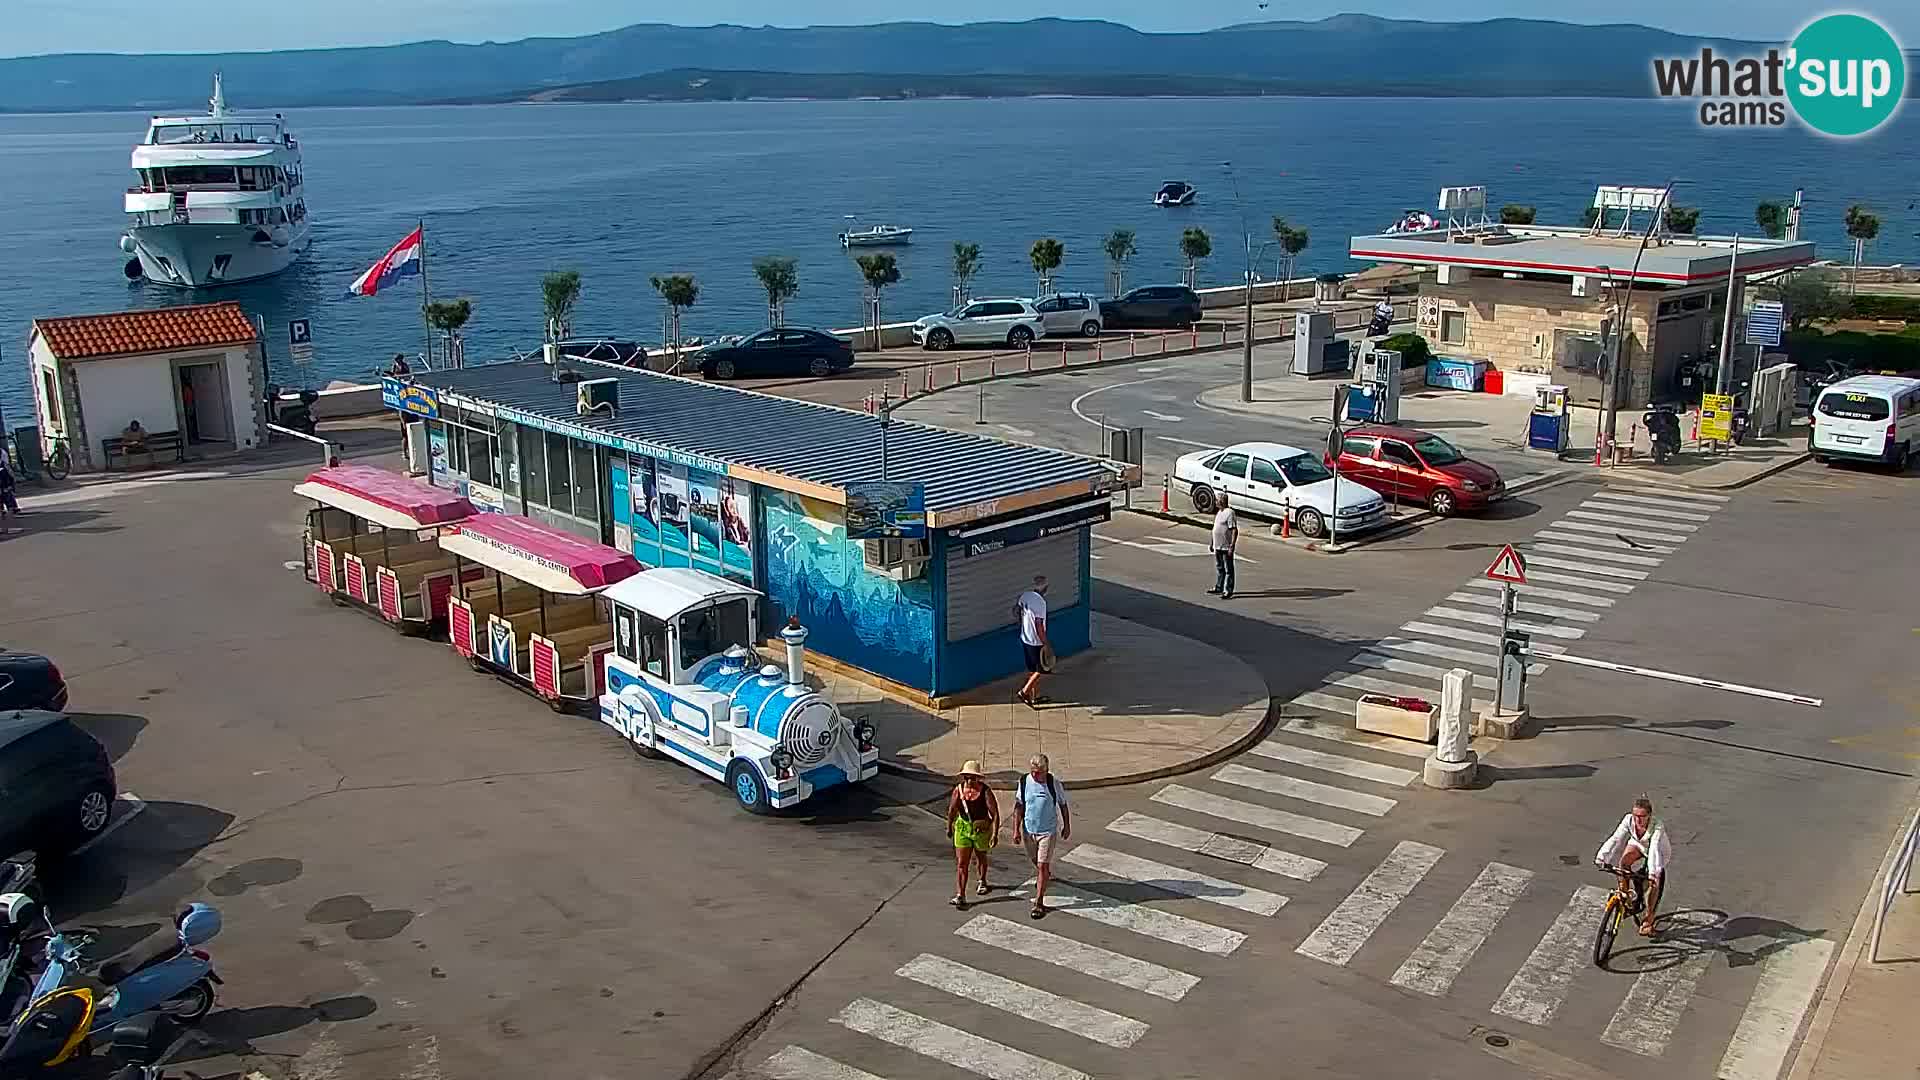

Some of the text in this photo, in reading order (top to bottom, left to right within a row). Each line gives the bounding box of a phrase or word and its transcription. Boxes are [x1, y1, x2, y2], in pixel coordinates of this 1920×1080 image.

[1846, 394, 1866, 403] TAXI
[543, 420, 584, 438] AUTOBUSNA
[583, 432, 613, 446] POSTAJA
[623, 440, 637, 452] BUS
[639, 444, 669, 460] STATION
[672, 451, 696, 466] TICKET
[698, 459, 724, 473] OFFICE
[548, 562, 568, 574] CENTER
